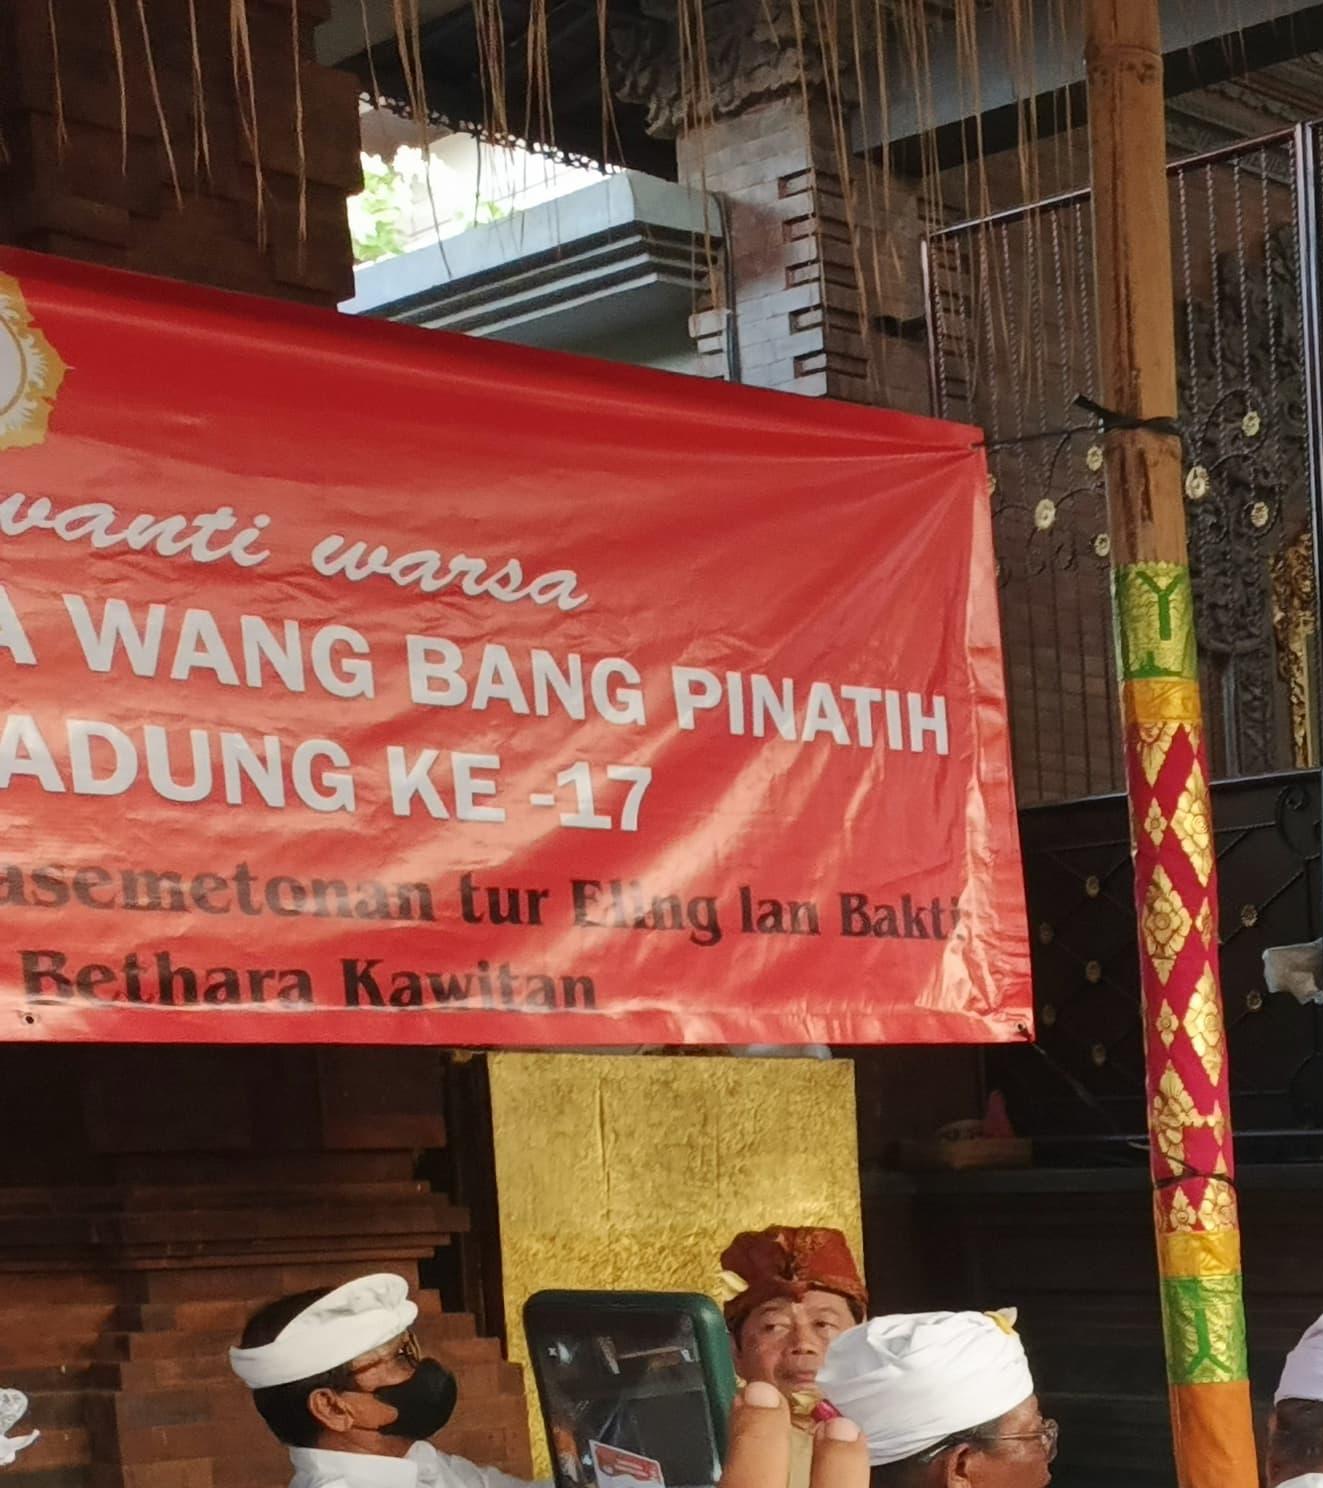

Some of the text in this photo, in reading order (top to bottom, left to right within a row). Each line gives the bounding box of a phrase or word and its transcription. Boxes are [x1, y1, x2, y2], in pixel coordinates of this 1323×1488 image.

[311, 534, 589, 612] warsa
[61, 593, 376, 700] WANG
[406, 634, 647, 728] BANG
[673, 666, 950, 756] PINATIH
[0, 714, 357, 813] ADUNG
[386, 745, 507, 823] KE
[460, 869, 549, 926] tur
[570, 879, 724, 947] Eling
[739, 886, 823, 938] lan
[17, 949, 597, 1012] Bethara Kawitan
